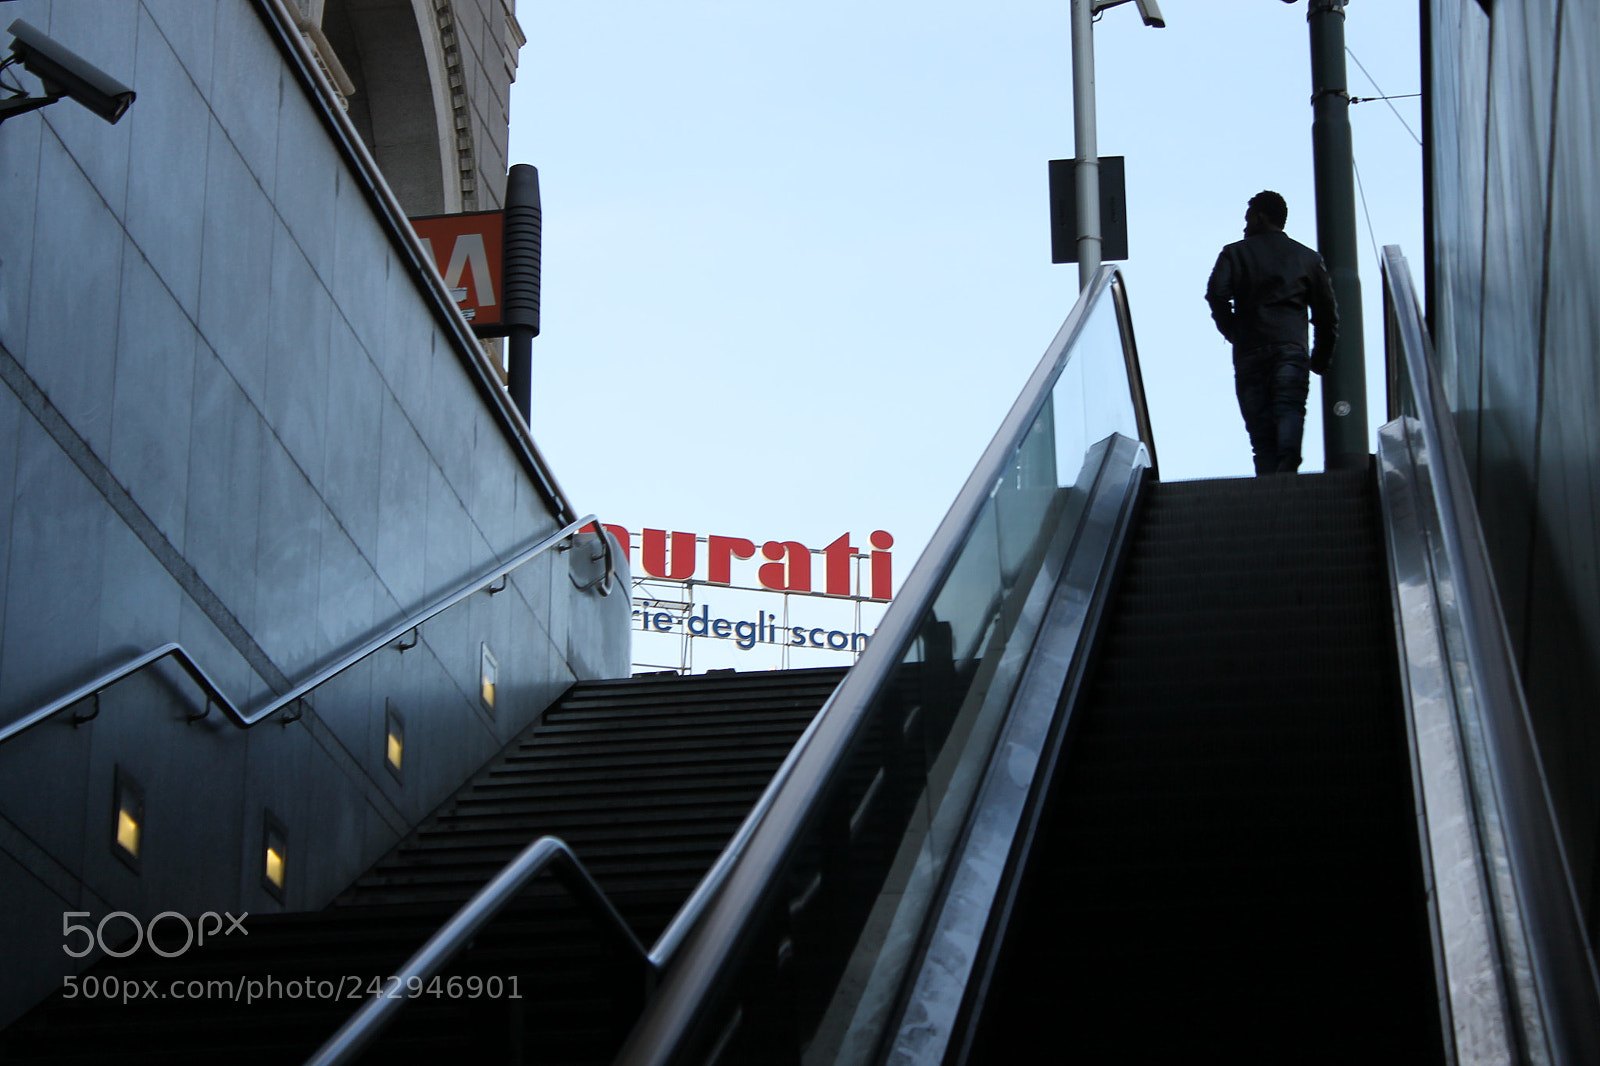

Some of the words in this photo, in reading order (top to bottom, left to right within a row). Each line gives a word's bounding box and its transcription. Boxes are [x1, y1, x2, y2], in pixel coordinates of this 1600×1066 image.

[579, 522, 894, 600] urati
[687, 604, 776, 650] degli
[791, 626, 878, 651] scon
